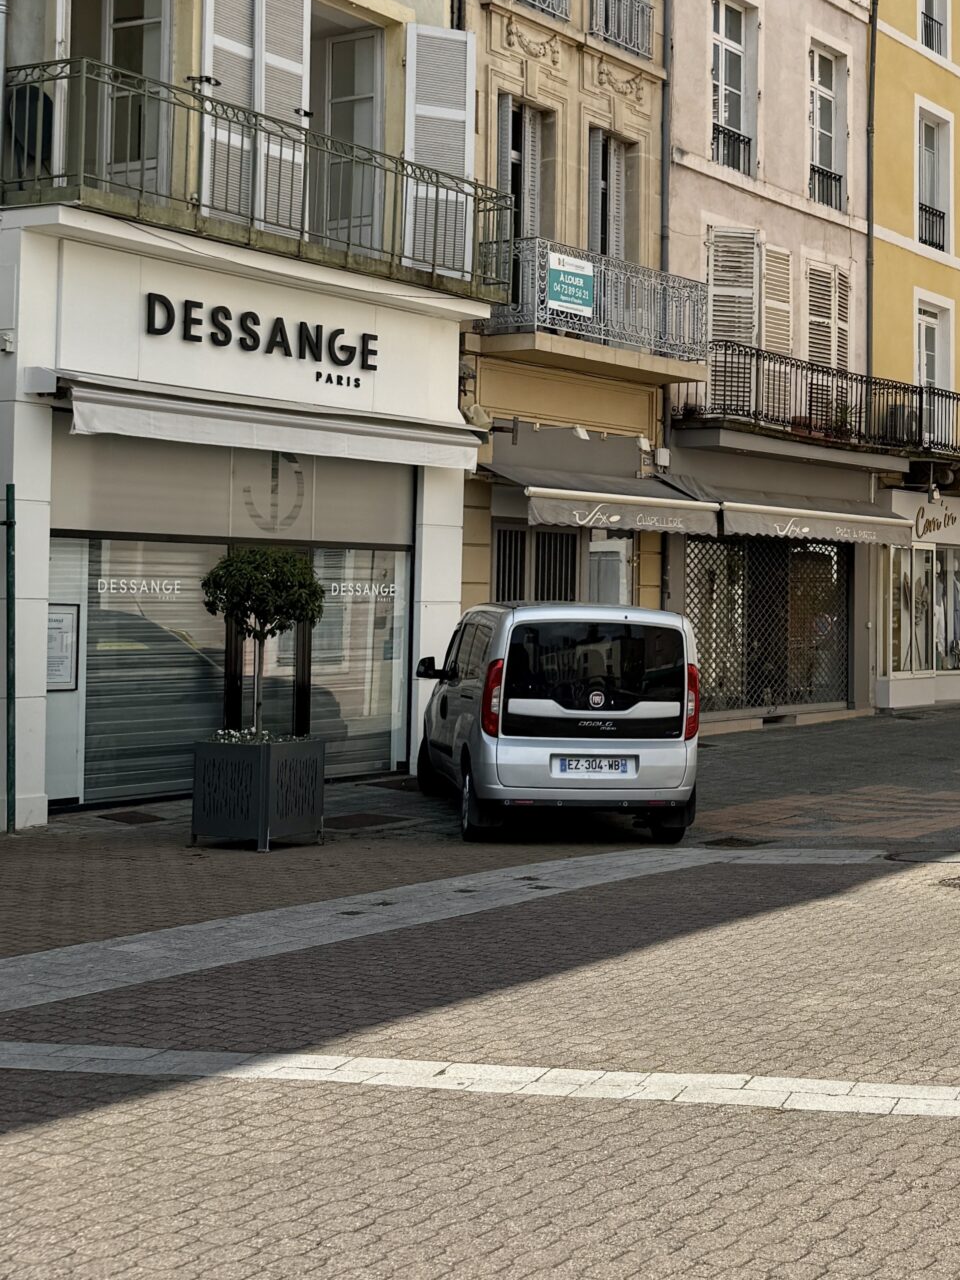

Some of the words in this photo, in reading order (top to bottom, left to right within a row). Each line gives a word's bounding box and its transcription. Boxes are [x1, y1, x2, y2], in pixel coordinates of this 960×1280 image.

[565, 274, 584, 287] LOUER
[554, 283, 561, 292] 04
[561, 284, 568, 294] 73
[146, 292, 379, 372] DESSANGE
[315, 371, 361, 388] PARIS
[98, 579, 181, 594] DESSANGE
[331, 583, 396, 596] DESSANGE
[567, 759, 620, 771] EZ-304-WB
